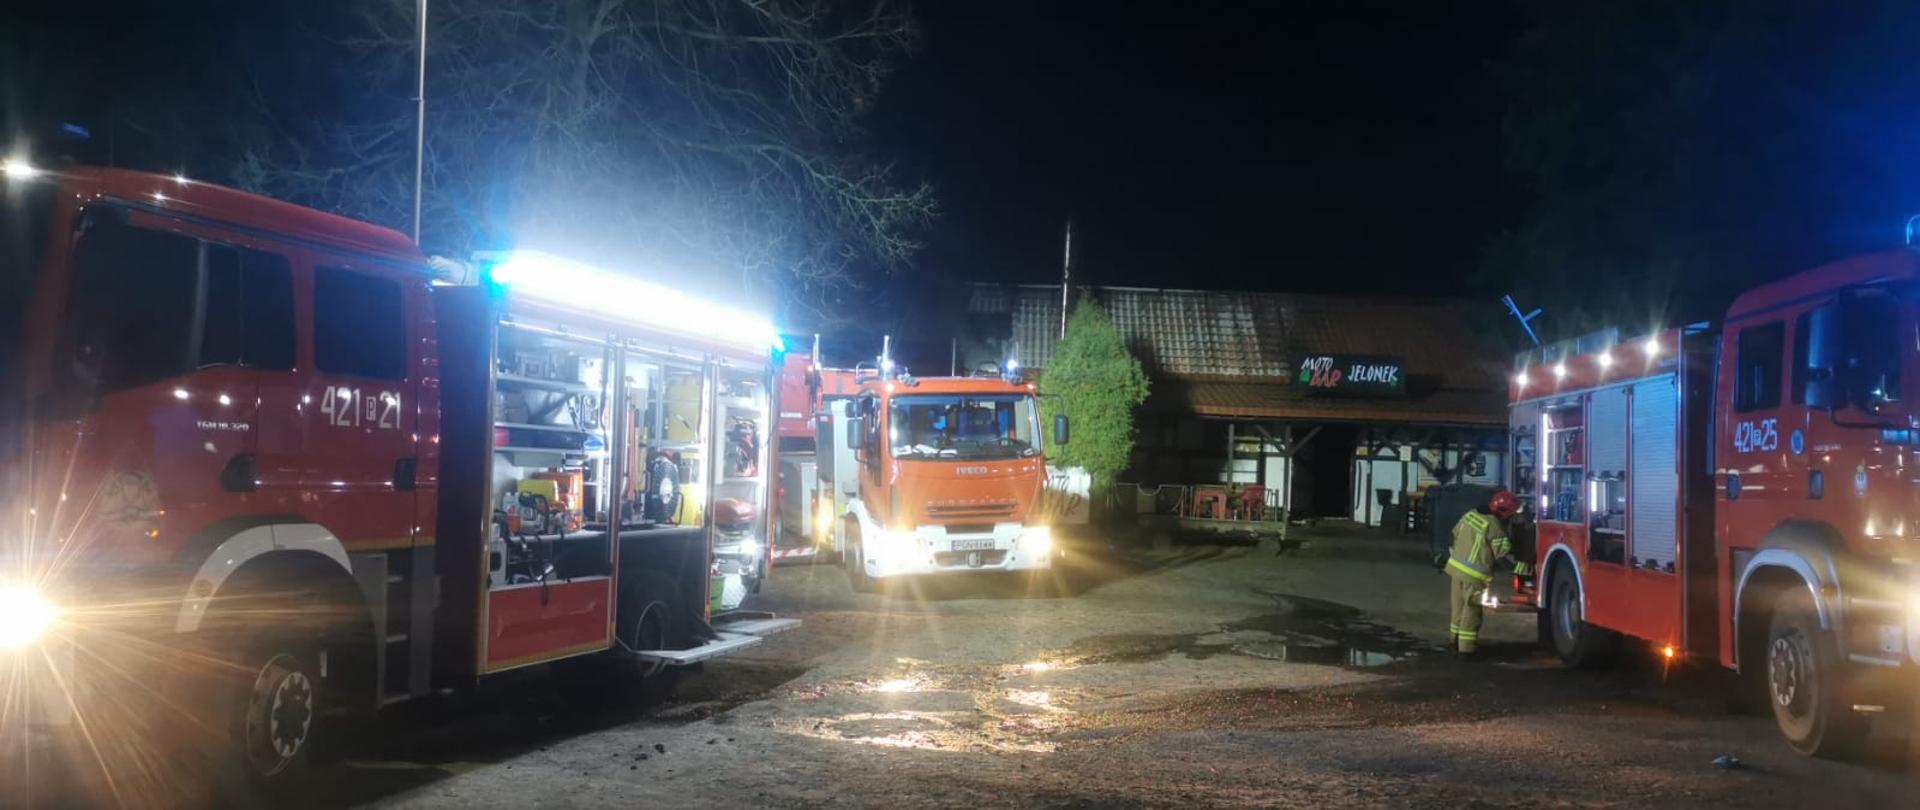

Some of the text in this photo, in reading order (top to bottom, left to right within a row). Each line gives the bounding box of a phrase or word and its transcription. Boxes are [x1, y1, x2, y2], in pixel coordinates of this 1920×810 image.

[1301, 356, 1334, 370] MOTO
[1309, 368, 1342, 388] BAR
[1347, 364, 1399, 383] JELONEK
[320, 385, 361, 428] 421
[379, 390, 401, 430] 21
[1734, 421, 1754, 453] 421
[1761, 418, 1778, 451] 25
[955, 465, 988, 476] IVECO
